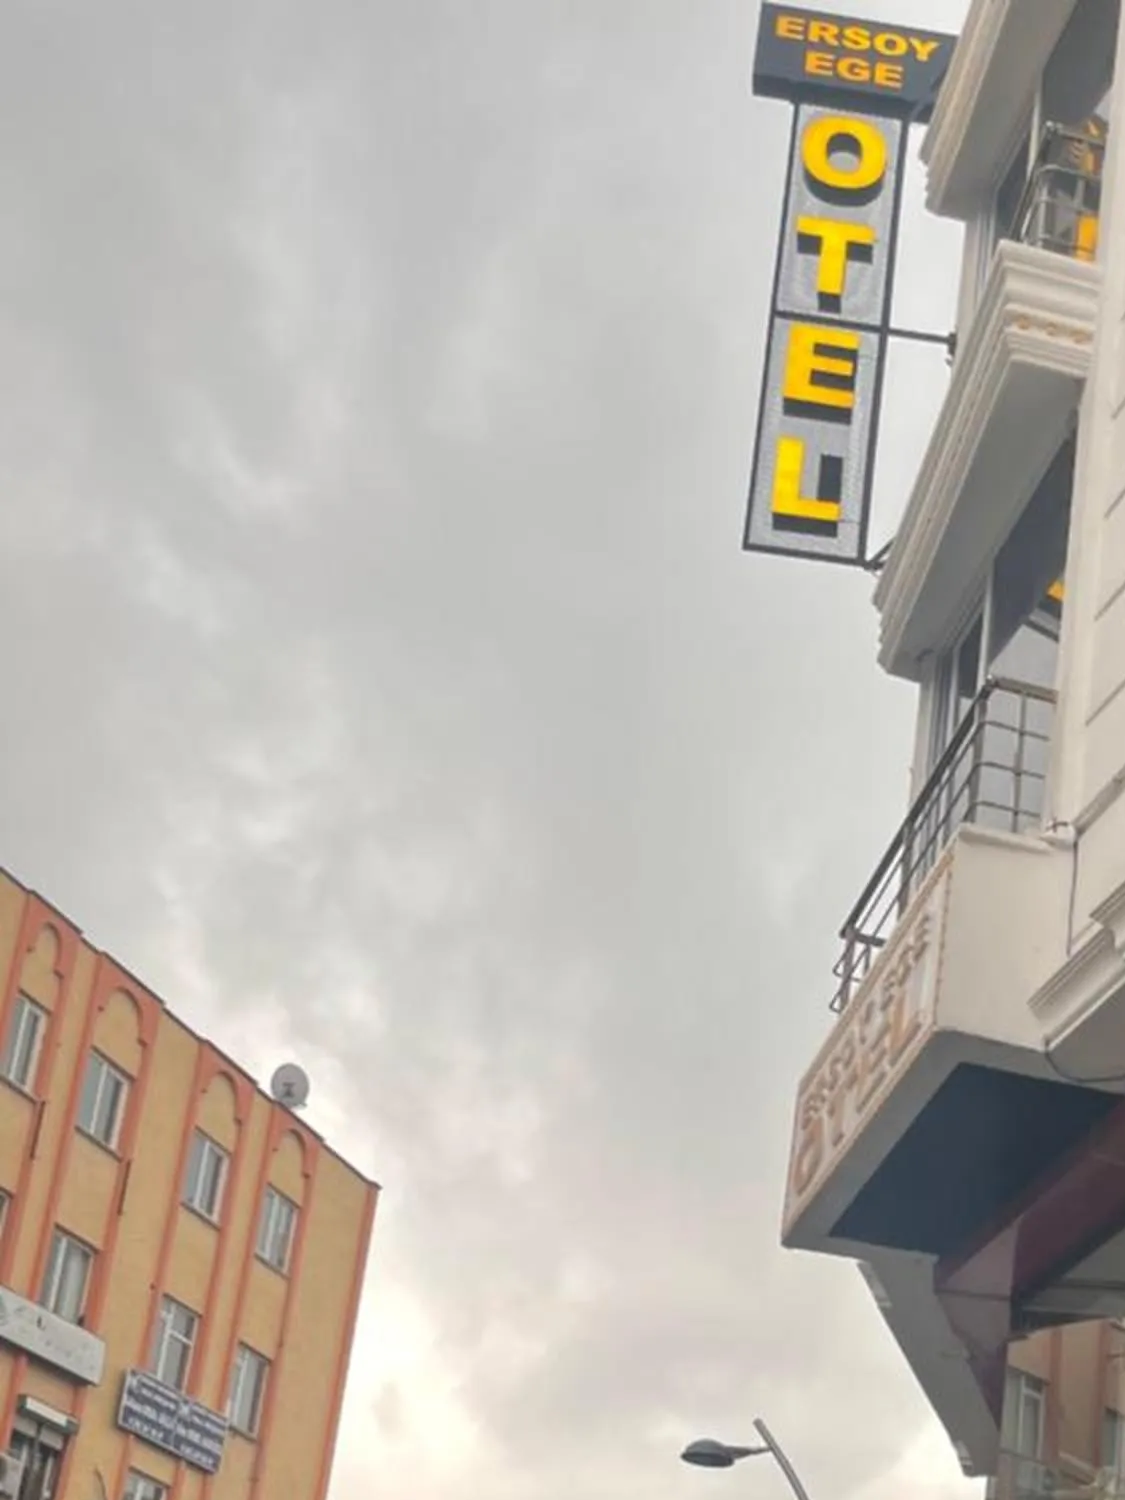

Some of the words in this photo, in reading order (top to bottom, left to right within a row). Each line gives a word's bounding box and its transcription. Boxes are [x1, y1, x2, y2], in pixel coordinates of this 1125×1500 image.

[774, 14, 940, 62] ERSOY
[804, 50, 904, 89] EGE
[771, 115, 888, 522] OTEL
